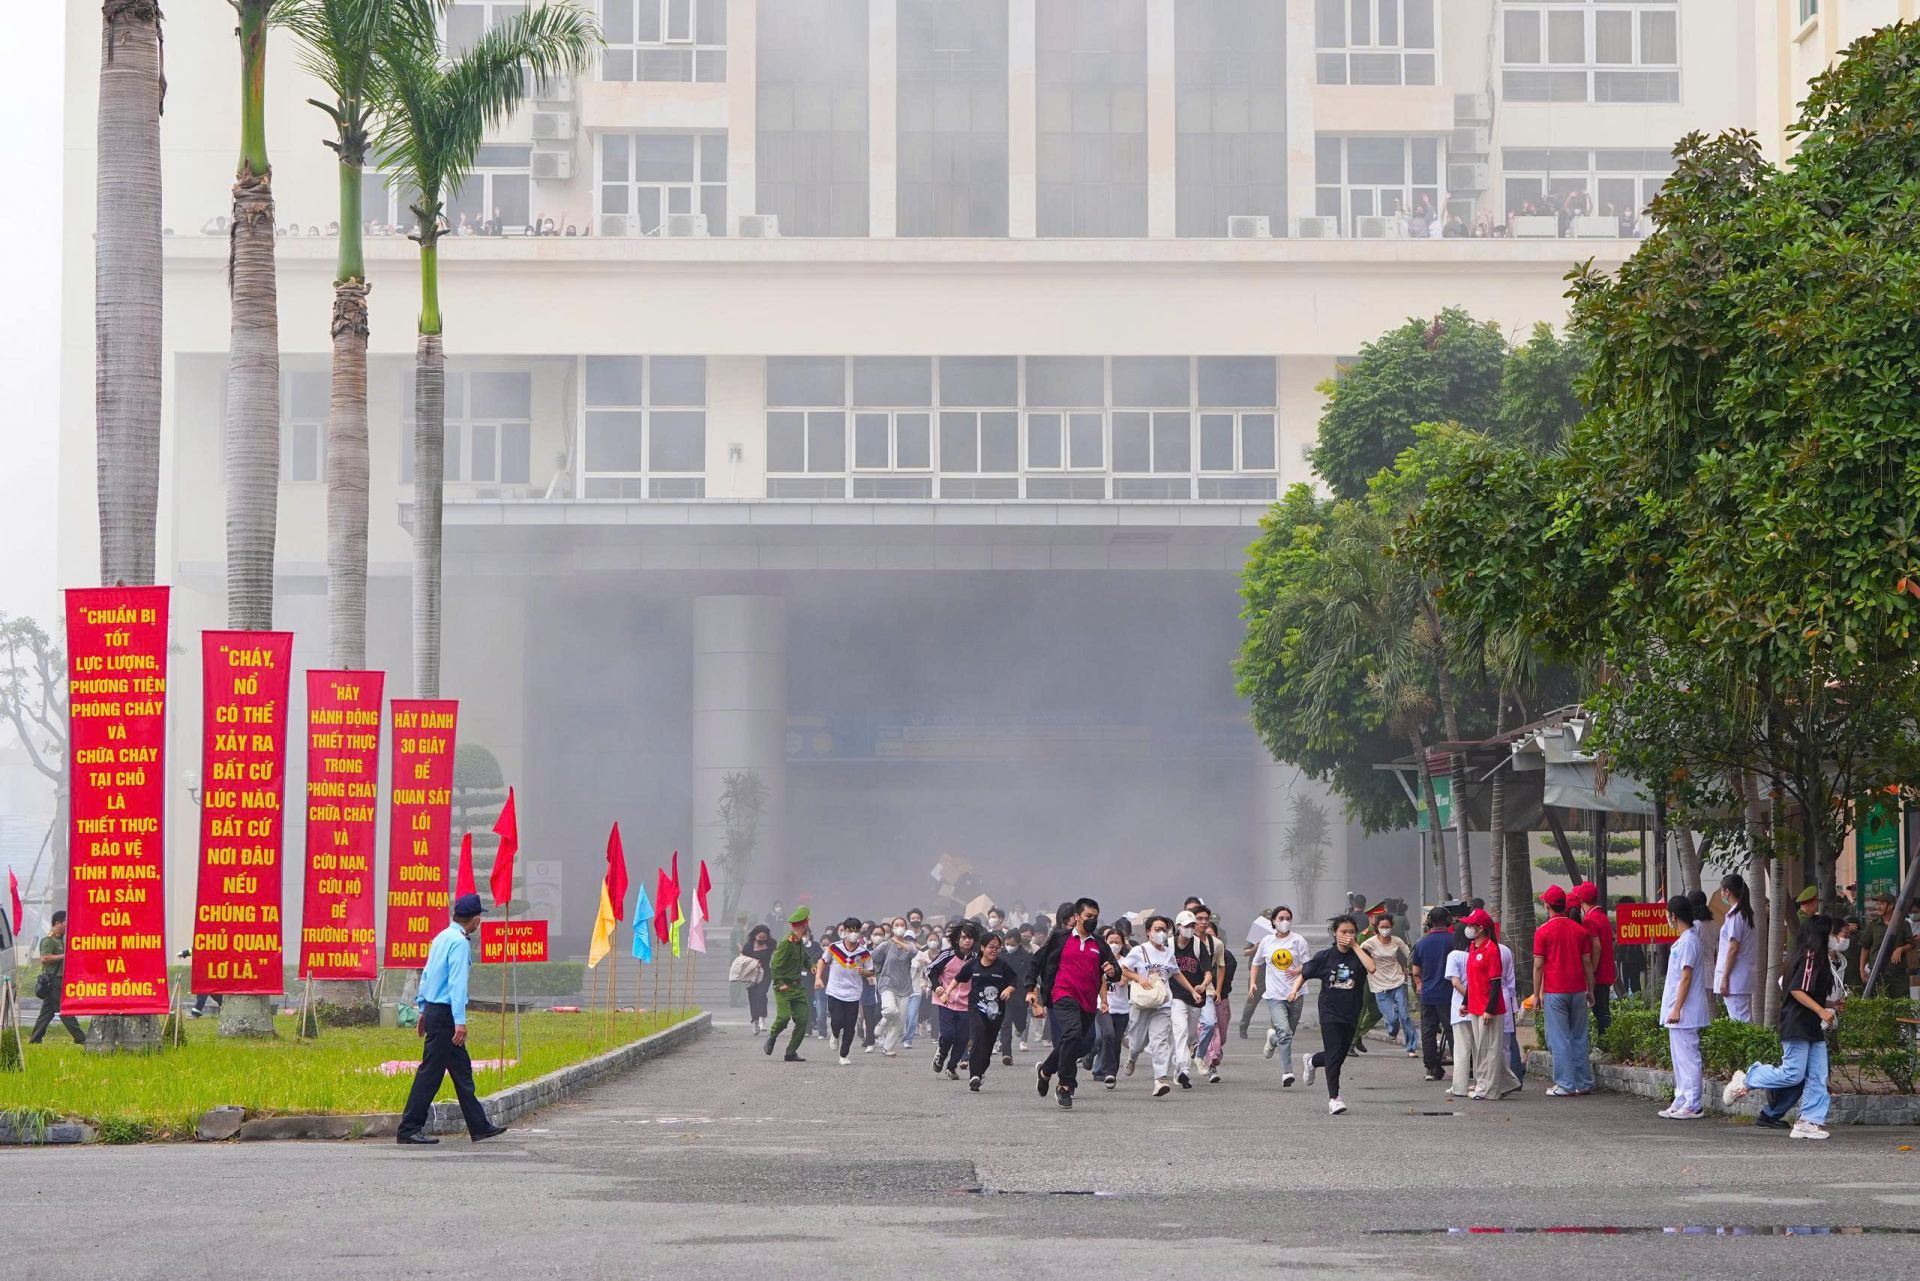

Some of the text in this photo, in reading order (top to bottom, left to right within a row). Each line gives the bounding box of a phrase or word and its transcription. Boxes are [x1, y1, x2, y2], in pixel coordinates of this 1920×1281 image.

[140, 608, 156, 625] BỊ
[104, 628, 131, 647] TỐT
[75, 655, 103, 673] LỰC
[69, 675, 166, 696] PHƯƠNG TIỆN
[233, 671, 259, 696] NỔ
[71, 698, 163, 718] PHÒNG CHÁY
[215, 700, 275, 724] CÓ THỂ
[311, 708, 379, 727] HÀNH ĐỘNG
[394, 709, 454, 729] HÃY DÀNH
[107, 723, 127, 740] VÀ
[214, 728, 274, 752] XẢY RA
[311, 731, 377, 752] THIẾT THỰC
[76, 746, 158, 764] CHỮA CHÁY
[400, 735, 446, 755] 30 GIÂY
[213, 757, 274, 781] BẤT CỨ
[323, 757, 363, 774] TRONG
[89, 766, 146, 789] TẠI CHỖ
[107, 792, 126, 810] LÀ
[205, 788, 237, 809] LÚC
[392, 787, 451, 806] QUAN SÁT
[309, 804, 375, 822] CHỮA CHÁY
[411, 811, 431, 831] LỐI
[76, 814, 158, 836] THIẾT THỰC
[211, 814, 273, 837] BẤT CỨ
[333, 828, 349, 846] VÀ
[412, 837, 429, 856] VÀ
[90, 837, 143, 859] BẢO VỆ
[207, 844, 275, 866] NƠI ĐÂU
[312, 853, 337, 870] CỨU
[73, 864, 107, 881] TÍNH
[399, 862, 441, 882] ĐƯỜNG
[223, 871, 257, 894] NẾU
[318, 877, 362, 897] CỨU HỘ
[87, 883, 146, 904] TÀI SẢN
[388, 888, 424, 907] THOÁT
[101, 907, 132, 927] CỦA
[199, 902, 279, 923] CHÚNG TA
[1631, 909, 1651, 918] KHU
[407, 916, 430, 933] NƠI
[514, 926, 533, 937] VỰC
[1620, 922, 1641, 938] CỨU
[71, 932, 162, 951] CHÍNH MÌNH
[195, 928, 228, 951] CHỦ
[302, 925, 376, 946] TRƯỜNG HỌC
[308, 952, 323, 968] AN
[392, 942, 417, 961] BẠN
[485, 943, 503, 960] NẠP
[520, 941, 544, 958] SẠCH
[106, 956, 126, 973] VÀ
[207, 960, 229, 980] LƠ
[65, 980, 108, 1000] CỘNG
